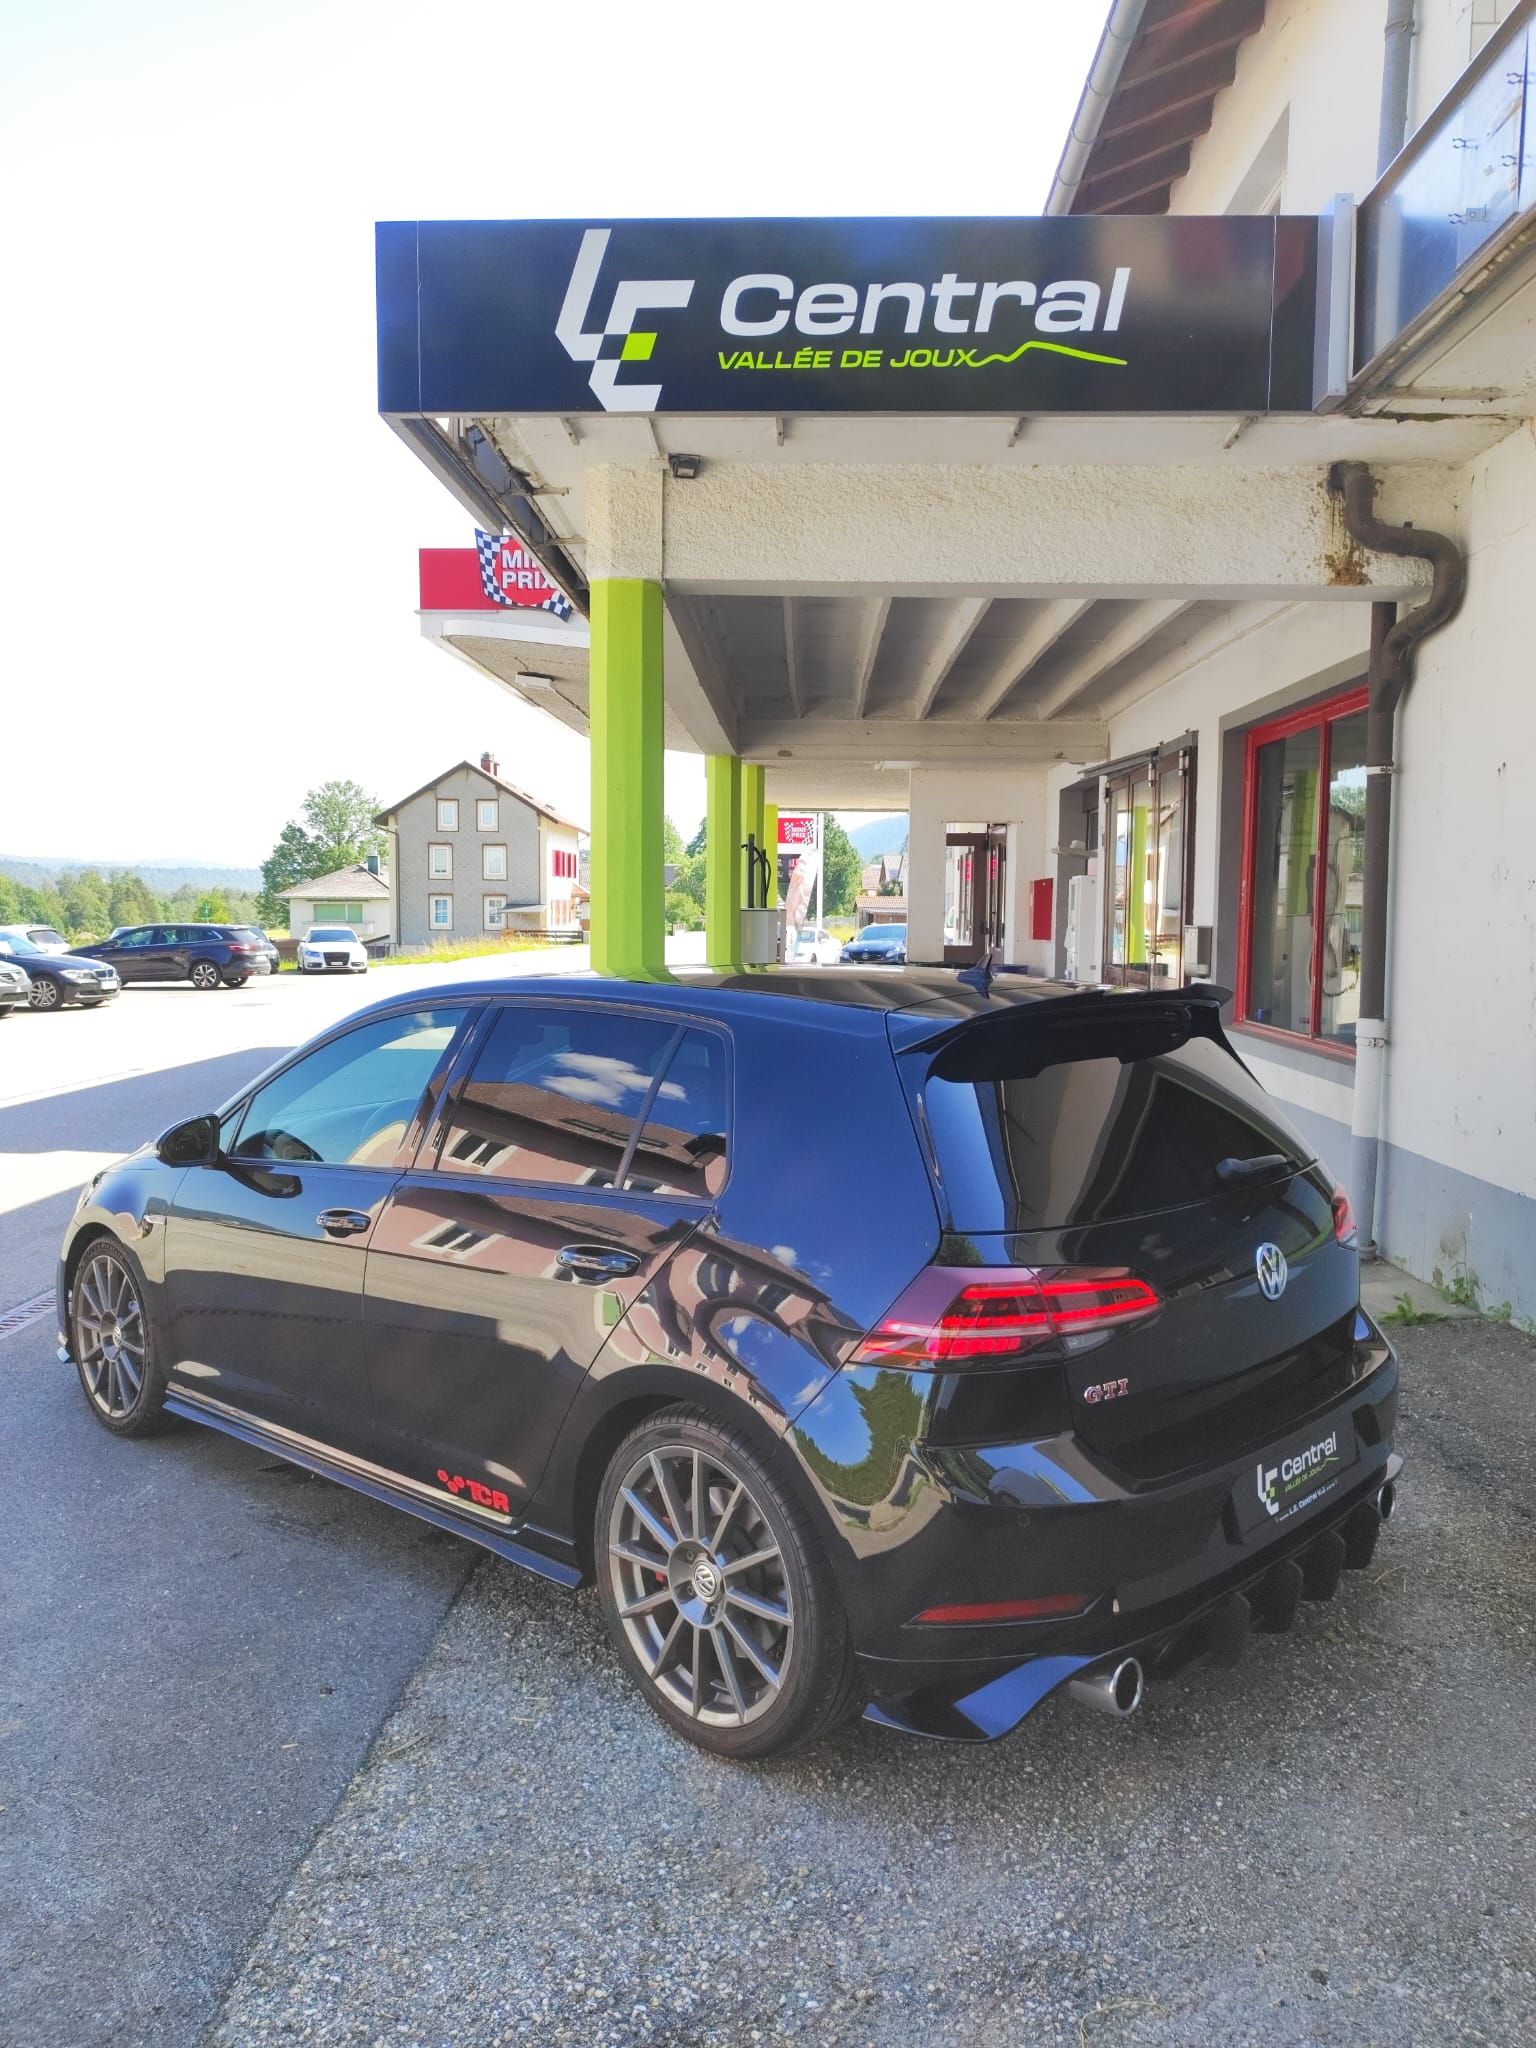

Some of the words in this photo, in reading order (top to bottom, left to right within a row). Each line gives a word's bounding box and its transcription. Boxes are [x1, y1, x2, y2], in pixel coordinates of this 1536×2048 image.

[720, 267, 1131, 337] Central
[718, 346, 833, 370] VALLÉE
[840, 349, 883, 368] DE
[889, 348, 979, 368] JOUX
[502, 549, 538, 569] MI
[502, 571, 557, 589] PRIX
[1084, 1378, 1129, 1404] GTI
[1281, 1431, 1337, 1481] Central
[465, 1480, 511, 1513] TCR
